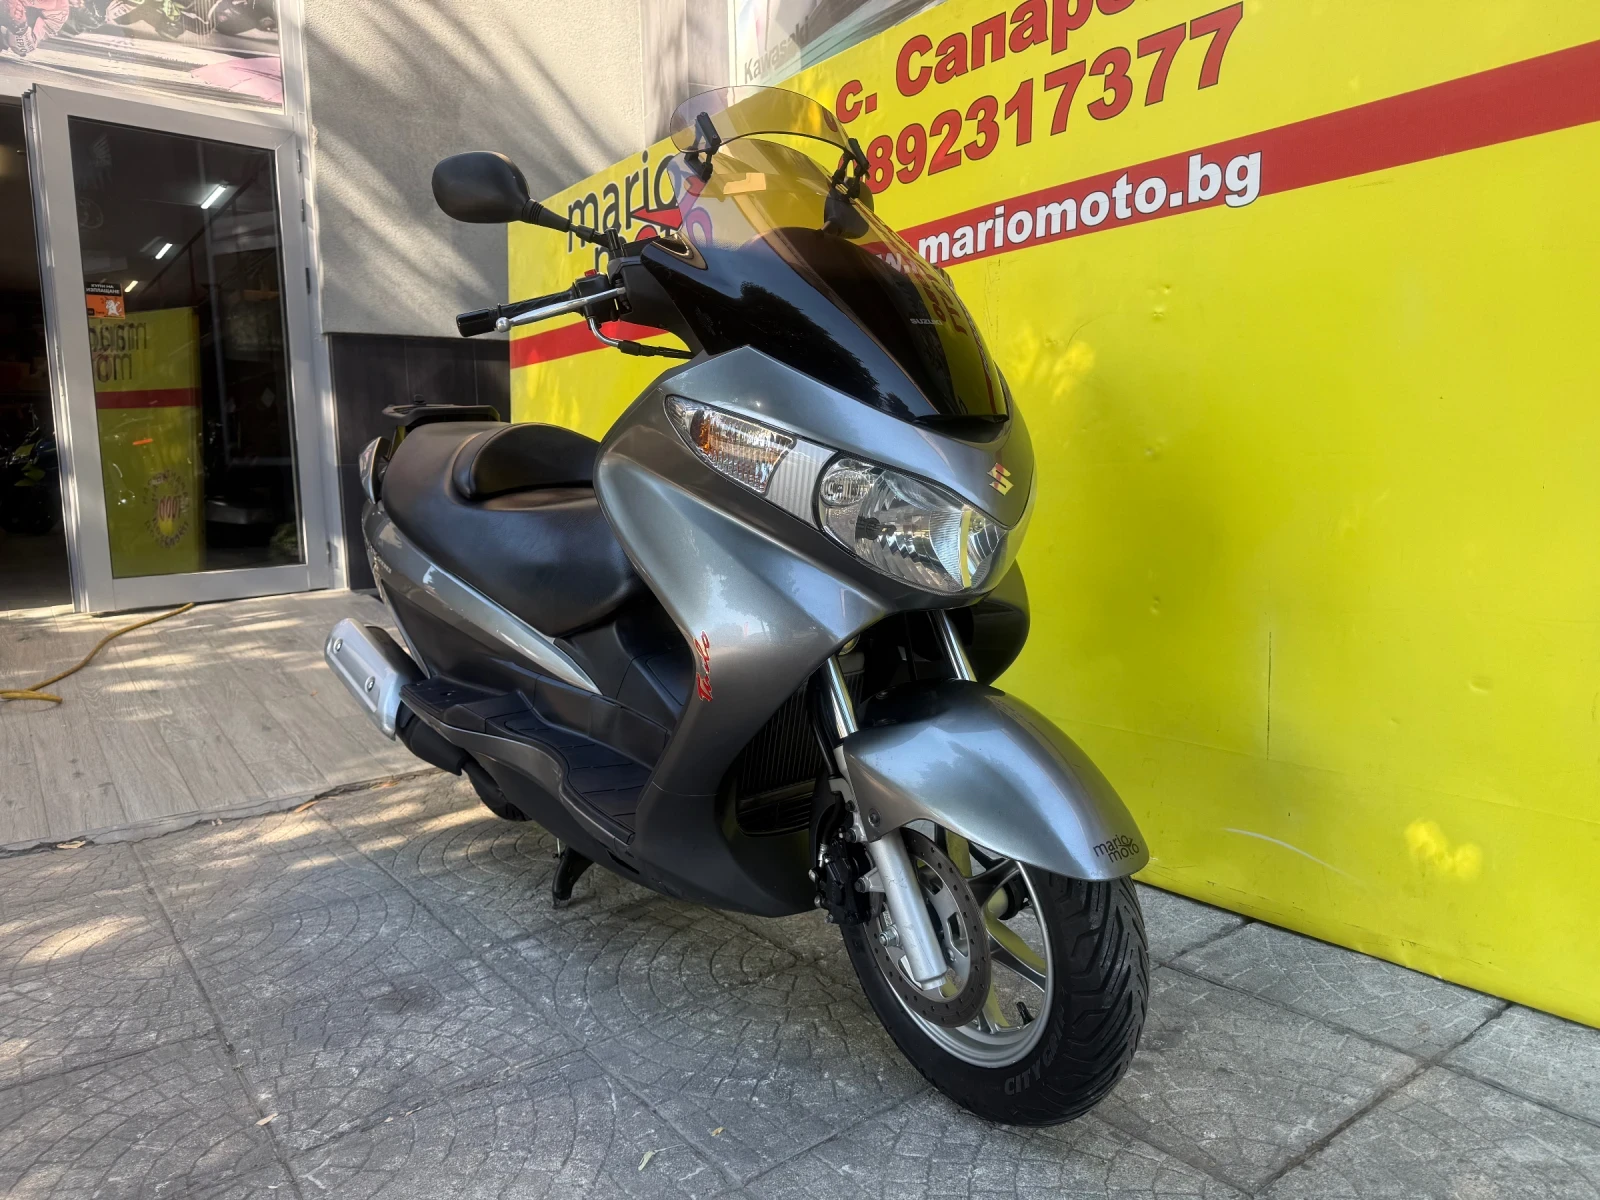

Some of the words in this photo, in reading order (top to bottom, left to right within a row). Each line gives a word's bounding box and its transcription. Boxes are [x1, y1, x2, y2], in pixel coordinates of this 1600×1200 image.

[744, 15, 809, 84] Kawasaki
[895, 0, 1134, 97] Сапар
[568, 150, 682, 253] mario
[909, 318, 944, 326] SUZUKI
[1092, 834, 1129, 857] mario
[1107, 839, 1140, 863] moto
[1004, 1057, 1041, 1096] CITY
